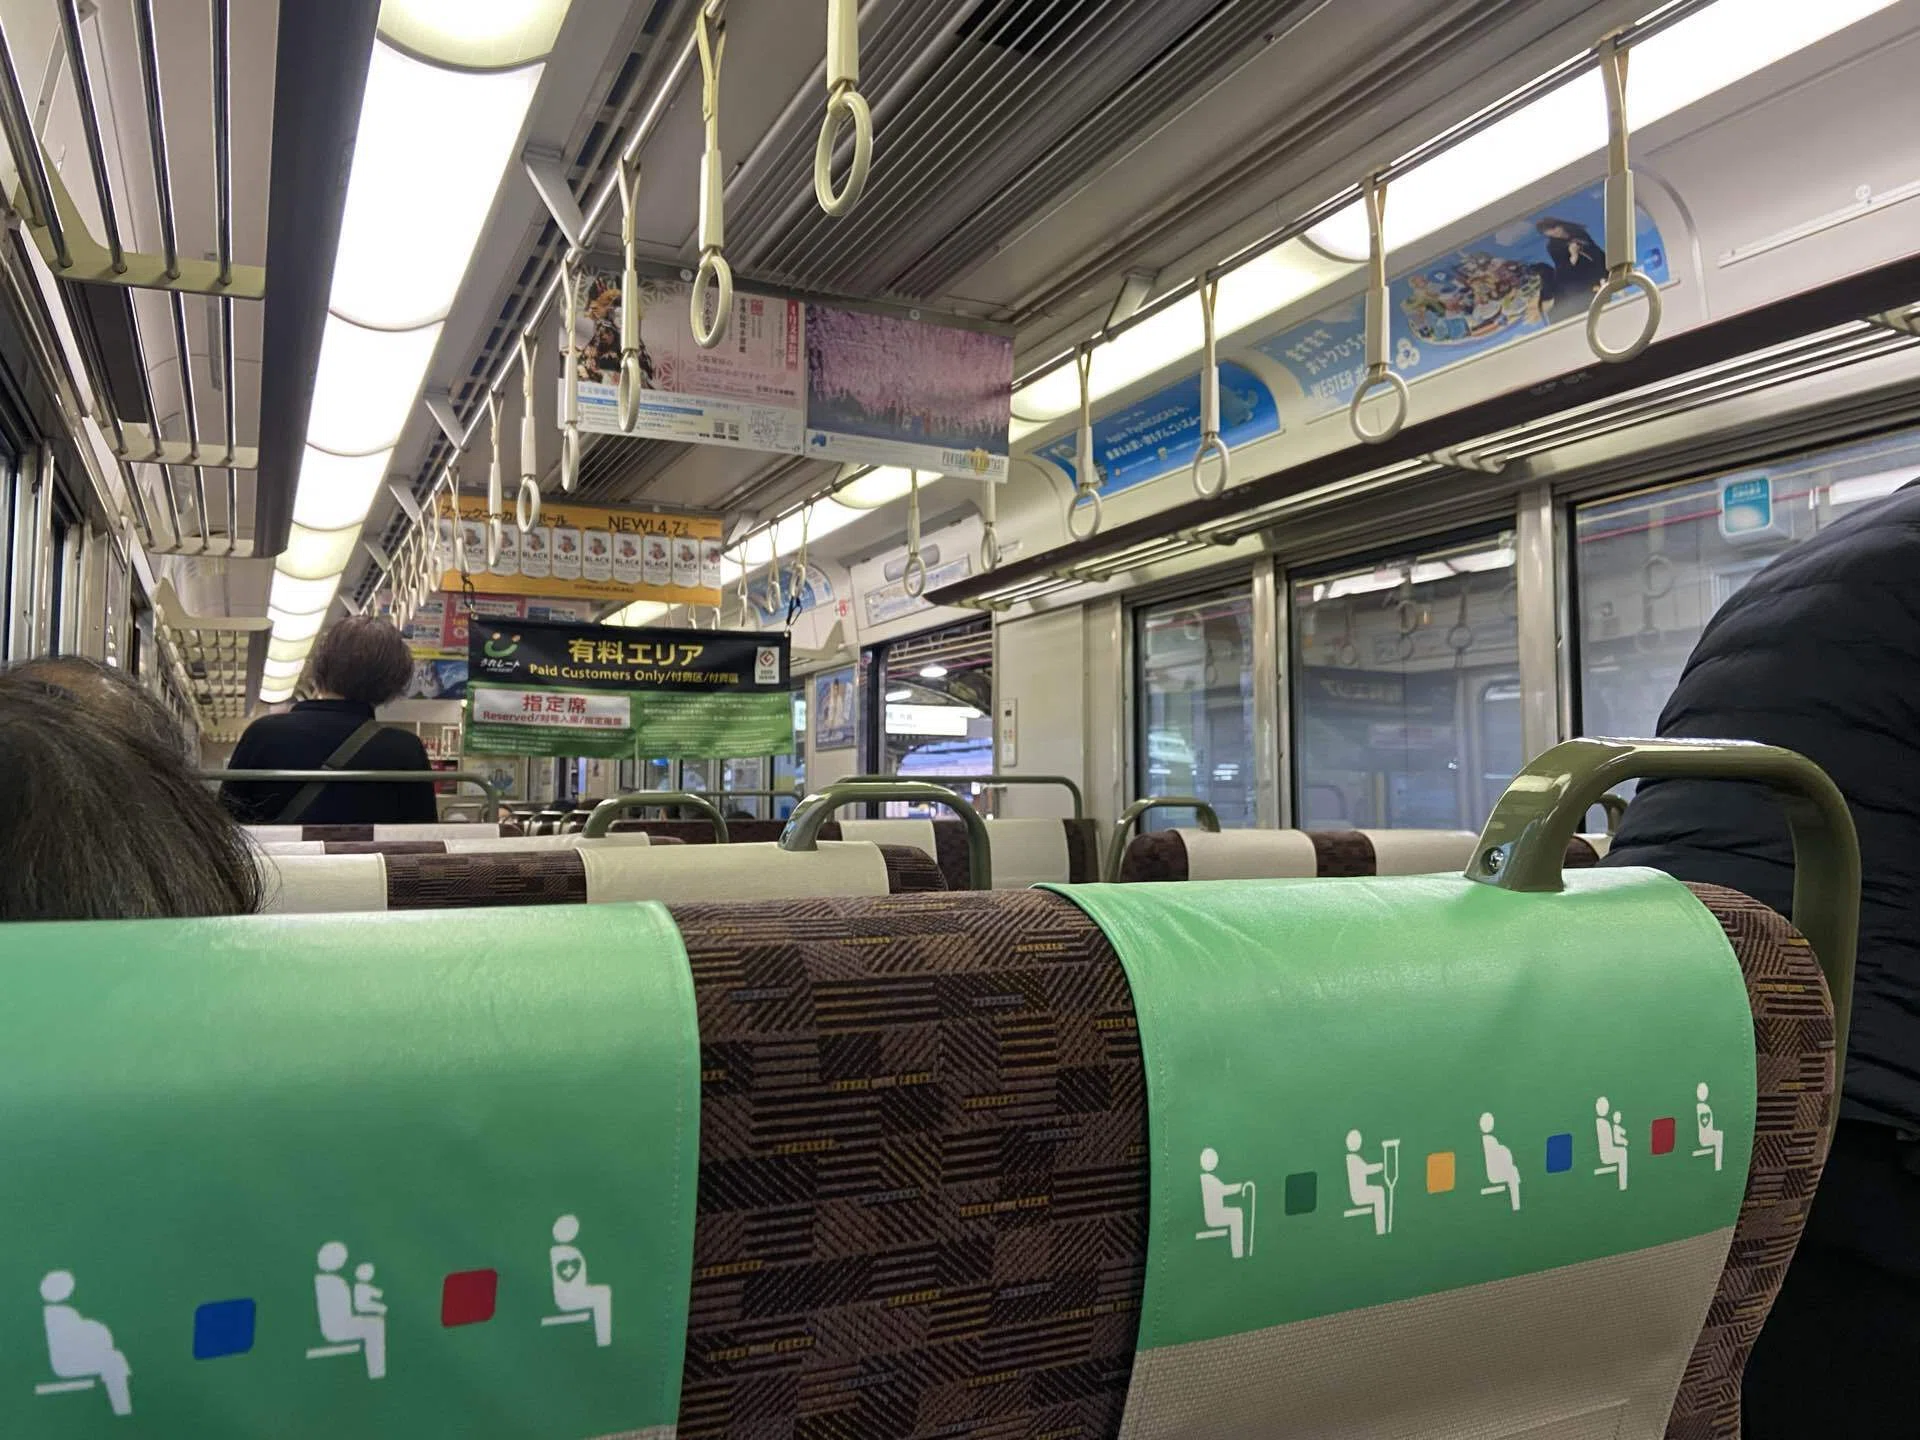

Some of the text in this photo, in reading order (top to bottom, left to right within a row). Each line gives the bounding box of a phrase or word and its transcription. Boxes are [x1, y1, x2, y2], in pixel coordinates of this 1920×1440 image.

[1310, 370, 1353, 399] WESTER
[608, 515, 654, 533] NEW!
[522, 551, 547, 559] BLACK
[615, 558, 639, 566] BLACK
[645, 561, 668, 569] BLACK
[568, 638, 704, 666] 有料エリア
[529, 663, 558, 676] Paid
[561, 667, 631, 681] Customers
[522, 693, 588, 714] 指定席
